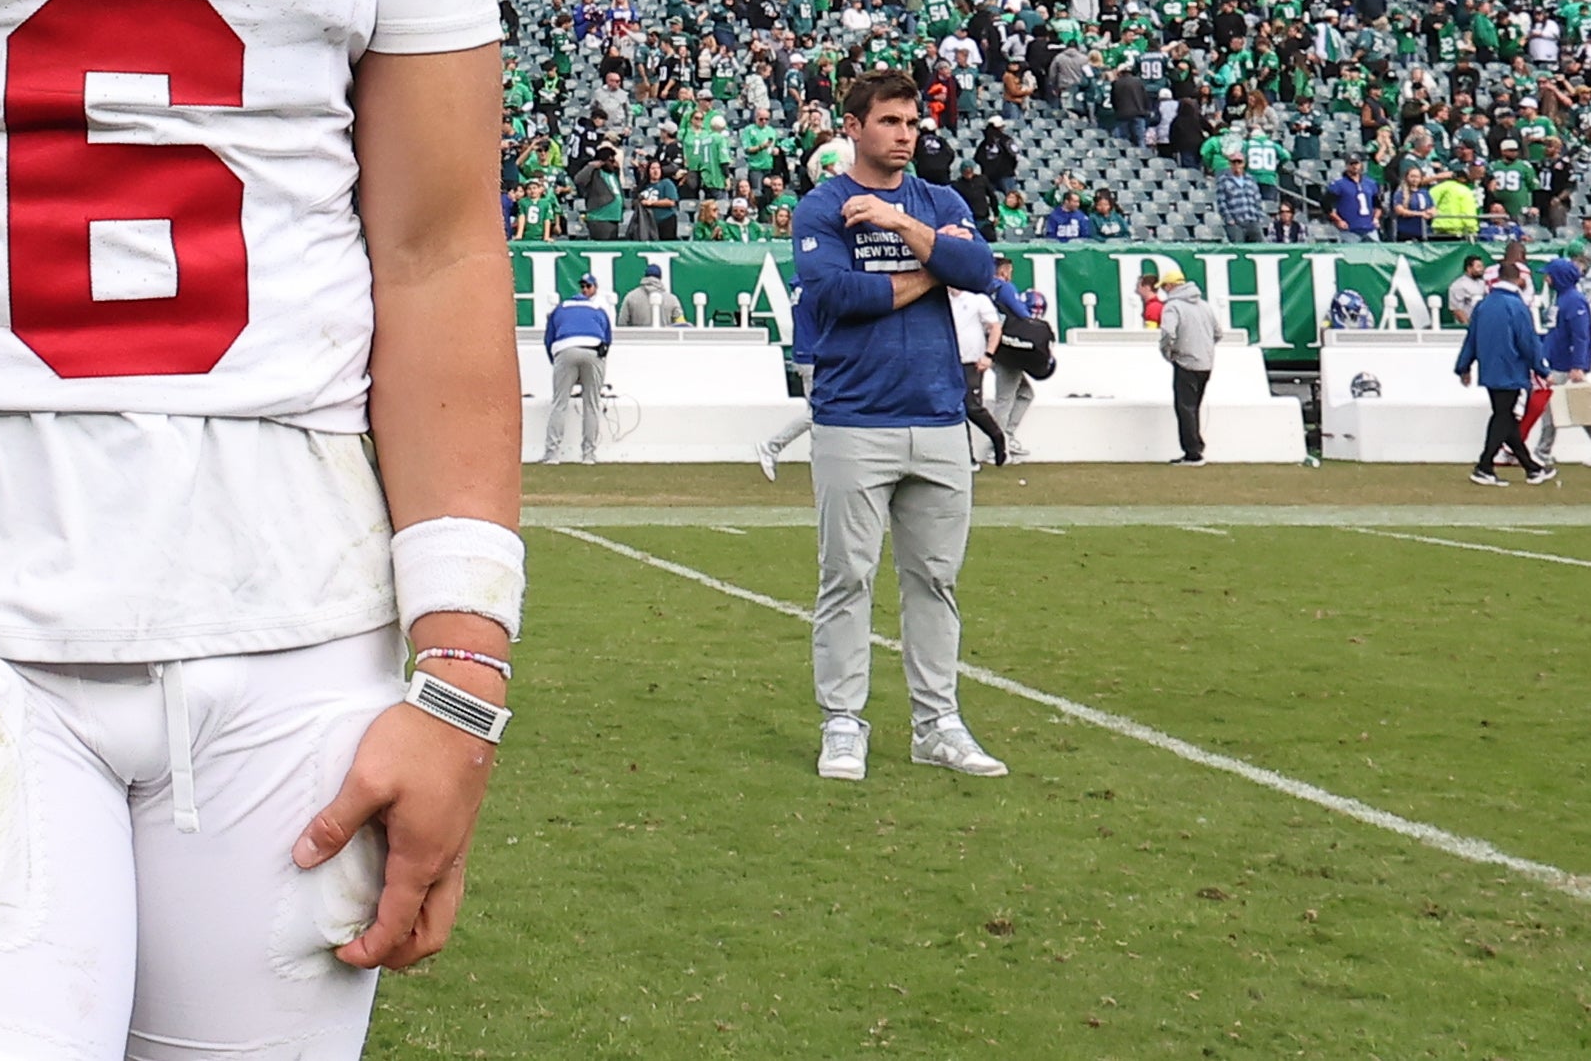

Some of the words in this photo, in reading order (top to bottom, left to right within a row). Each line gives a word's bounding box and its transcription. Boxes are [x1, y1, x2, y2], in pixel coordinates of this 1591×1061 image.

[928, 4, 950, 22] 54
[1140, 61, 1163, 79] 99
[1247, 147, 1277, 171] 60
[1357, 193, 1370, 216] 1
[527, 205, 540, 224] 6
[854, 245, 882, 259] NEW
